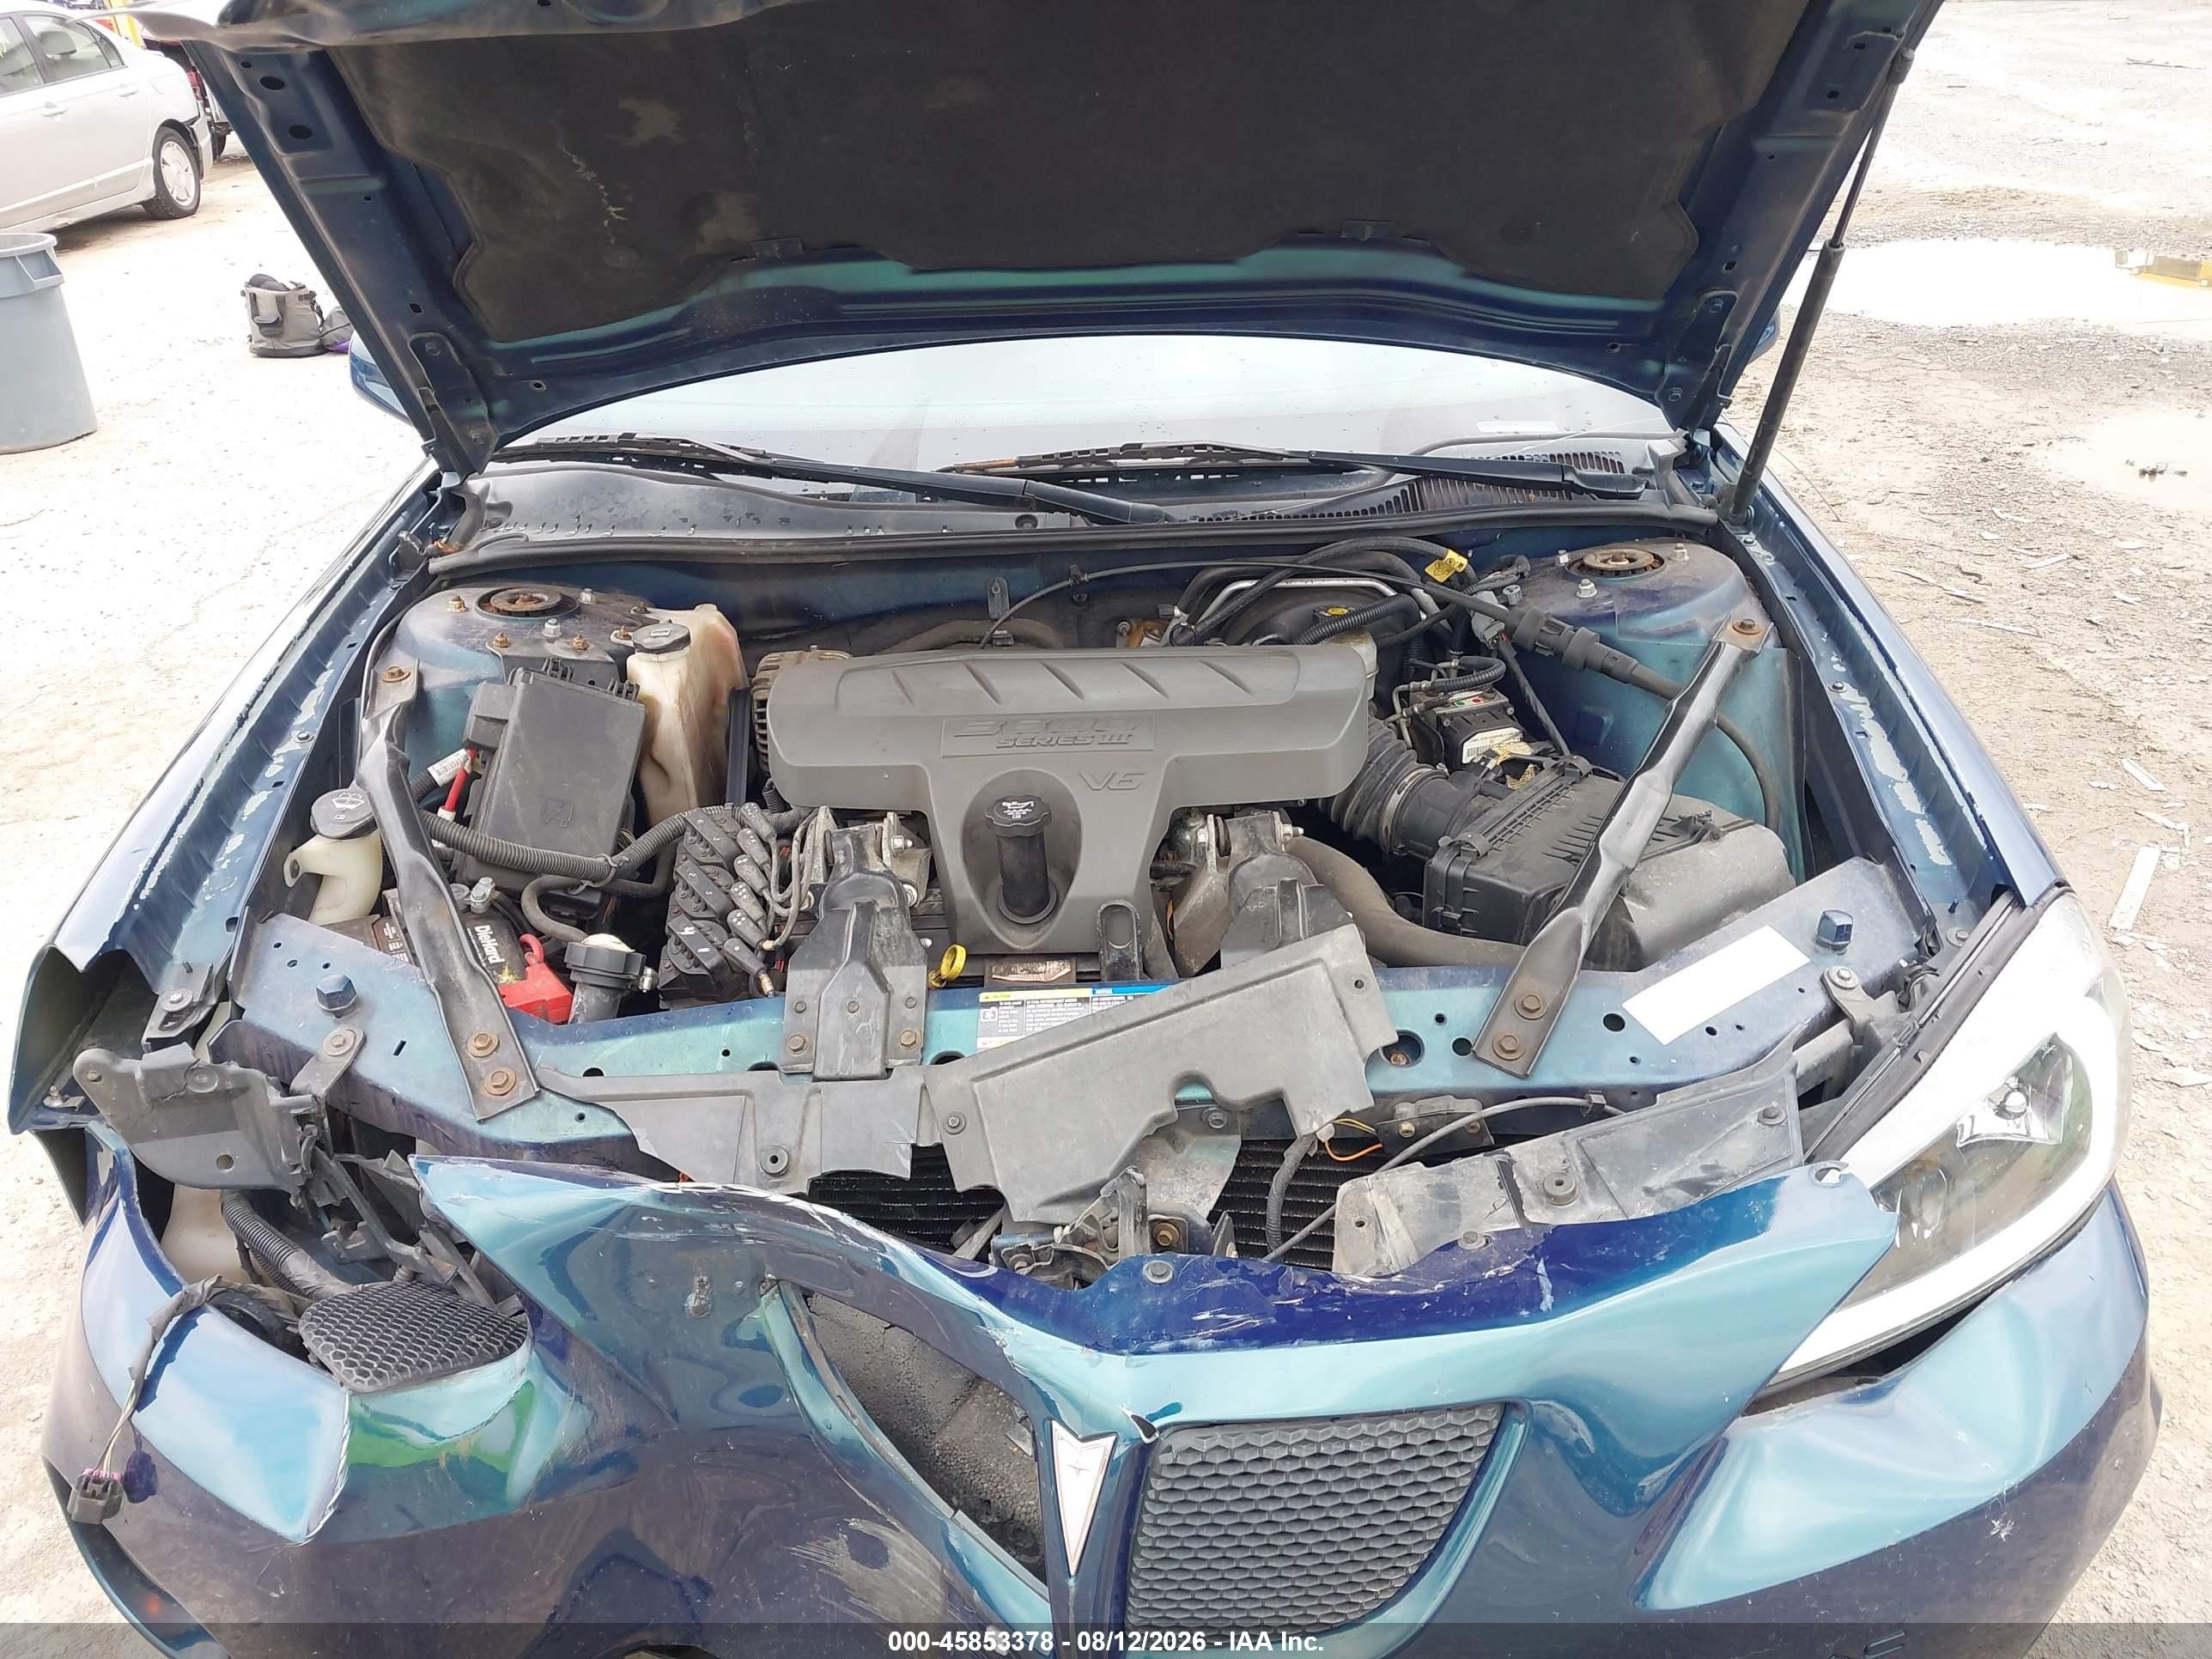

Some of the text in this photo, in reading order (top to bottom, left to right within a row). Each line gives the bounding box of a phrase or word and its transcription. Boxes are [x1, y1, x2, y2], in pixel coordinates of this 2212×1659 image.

[995, 733, 1134, 749] SERIES III
[1078, 769, 1146, 792] V6
[474, 925, 506, 964] DieHard
